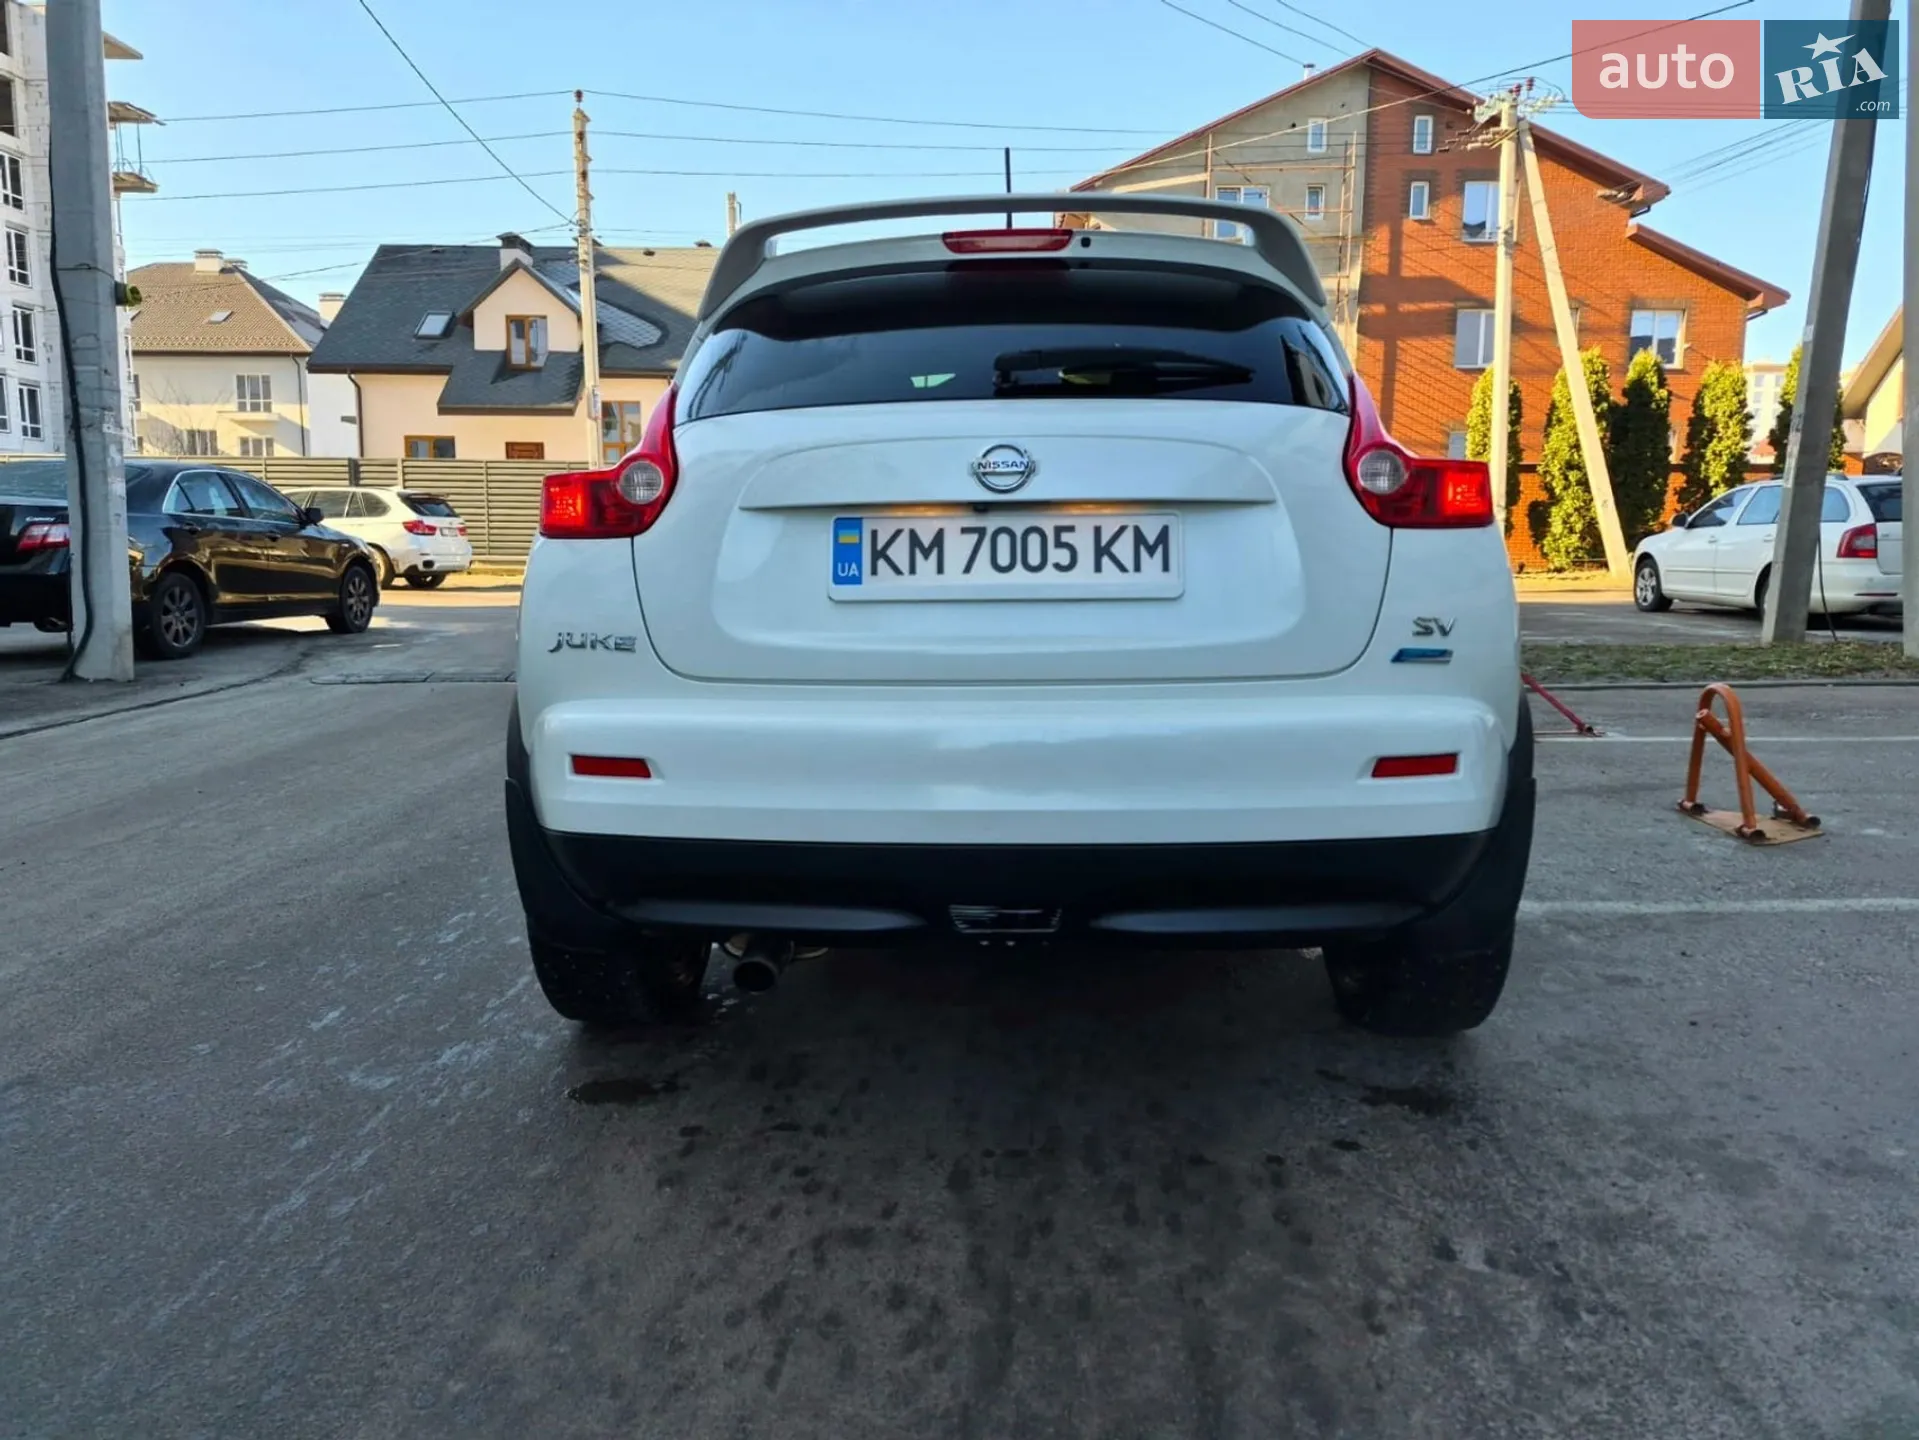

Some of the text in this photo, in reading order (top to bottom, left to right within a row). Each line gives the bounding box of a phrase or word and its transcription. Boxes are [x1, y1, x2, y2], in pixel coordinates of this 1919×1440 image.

[977, 460, 1030, 470] NISSAN
[870, 524, 1170, 576] KM 7005 KM
[837, 561, 860, 577] UA
[1411, 616, 1457, 637] SV
